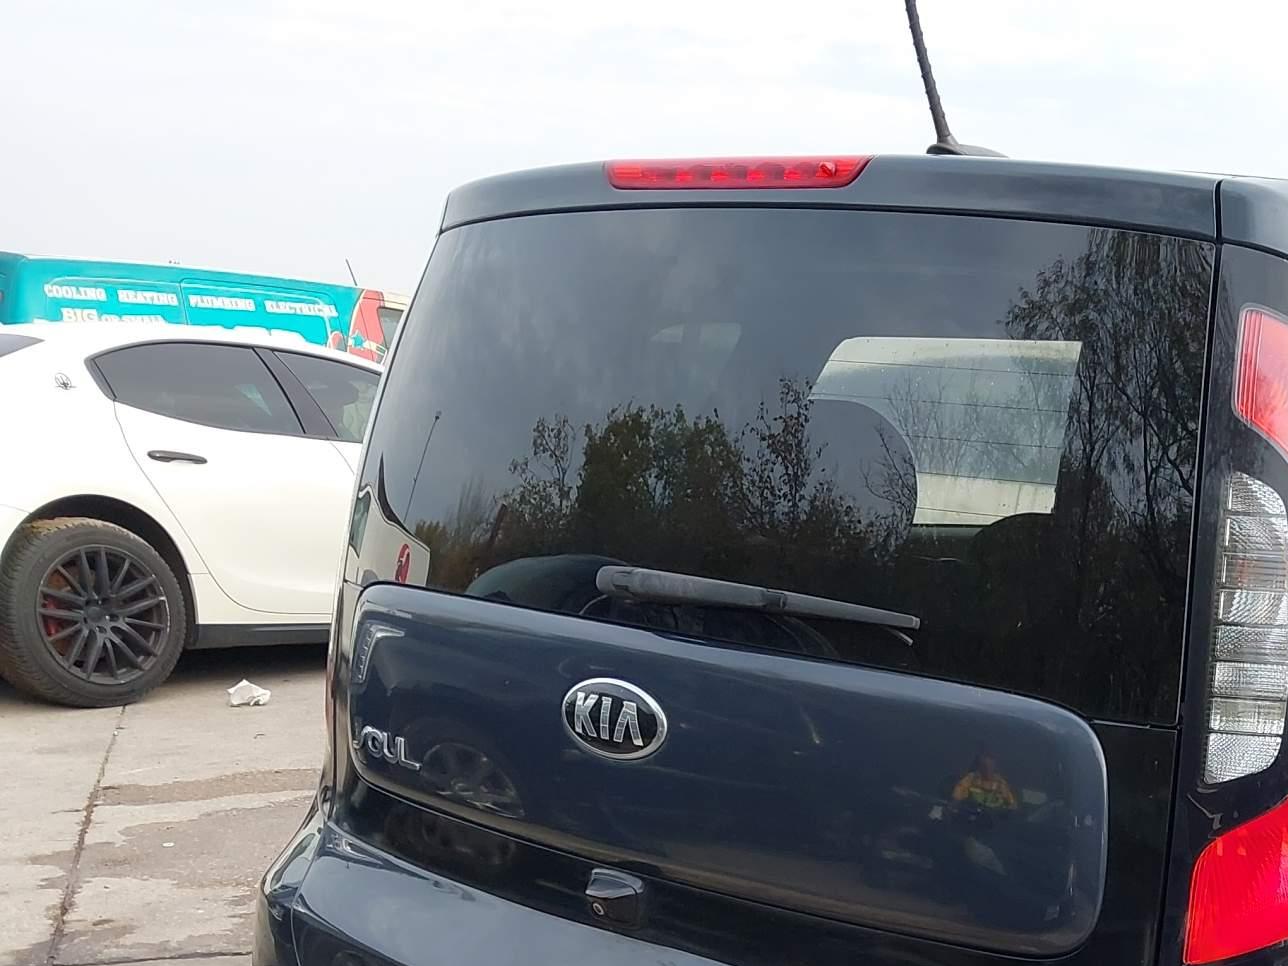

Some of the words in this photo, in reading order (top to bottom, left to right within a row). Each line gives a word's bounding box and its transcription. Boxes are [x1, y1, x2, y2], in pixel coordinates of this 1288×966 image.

[45, 285, 105, 300] COOLING
[118, 290, 177, 304] HEATING
[190, 297, 254, 310] PLUMBING
[574, 691, 644, 747] KIA
